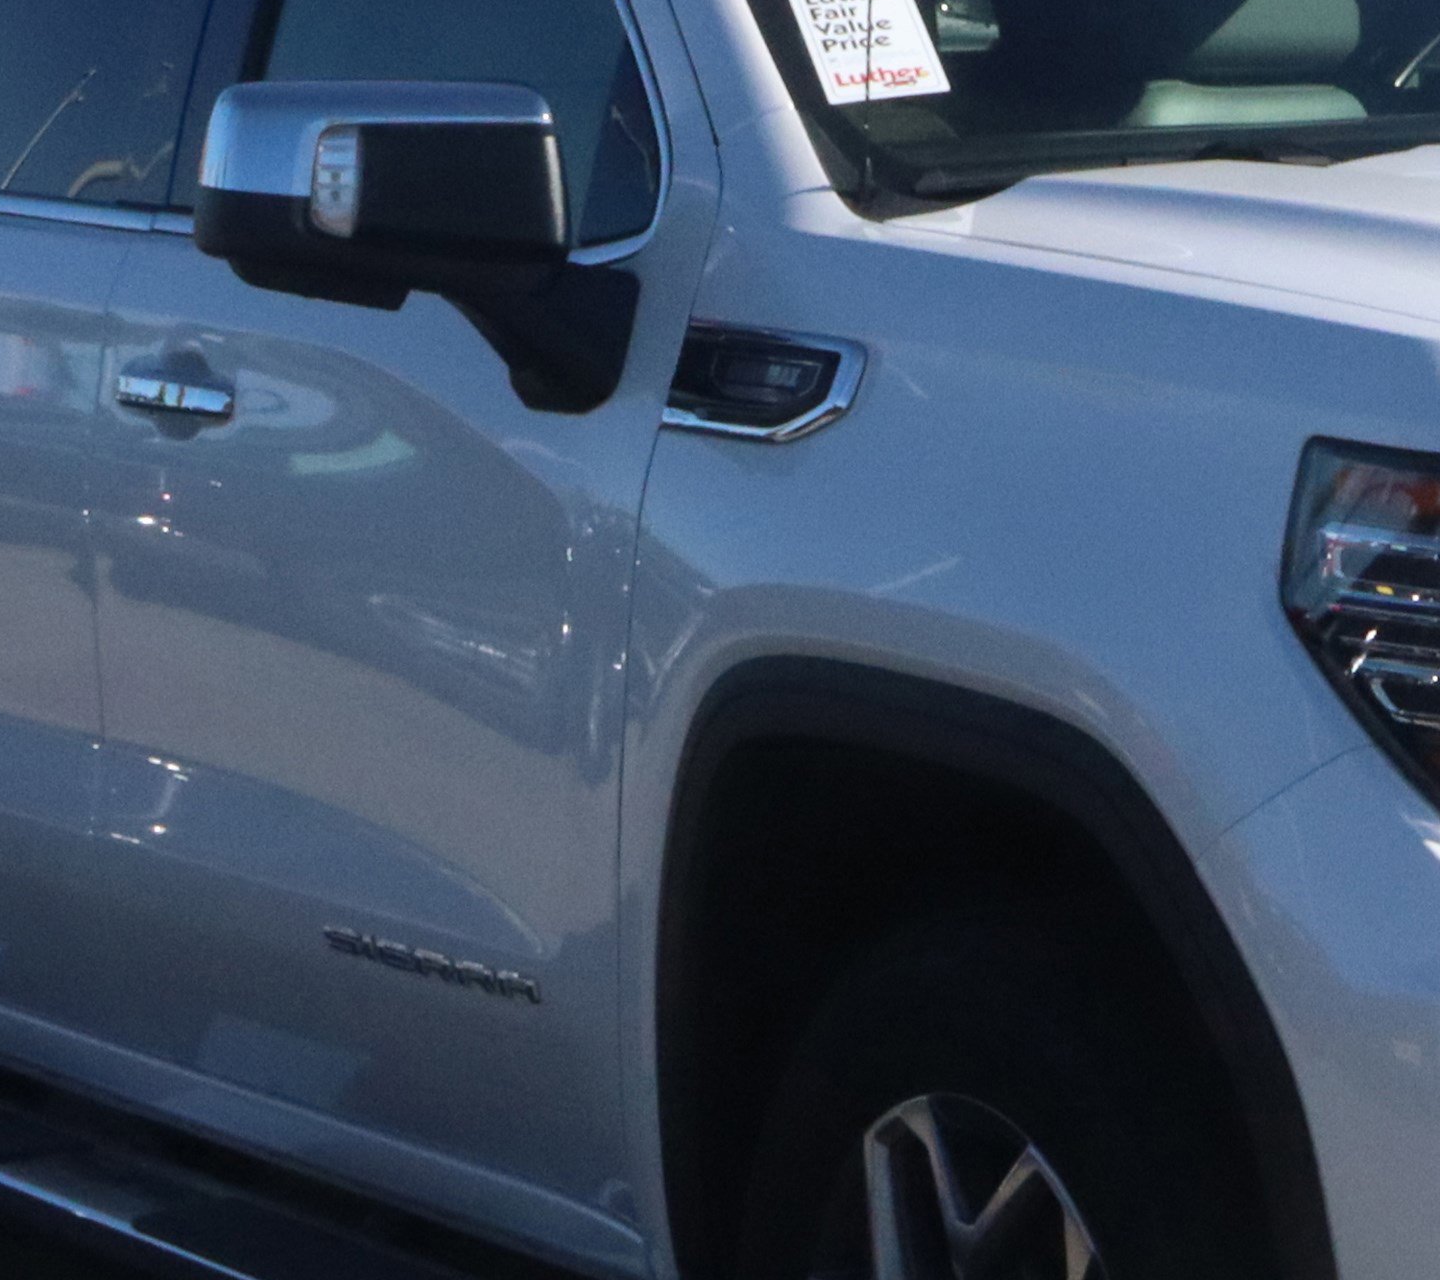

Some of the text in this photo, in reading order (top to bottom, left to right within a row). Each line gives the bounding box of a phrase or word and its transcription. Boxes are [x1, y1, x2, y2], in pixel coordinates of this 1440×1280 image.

[810, 3, 858, 22] Fair
[815, 19, 892, 36] Value
[821, 33, 891, 53] Price
